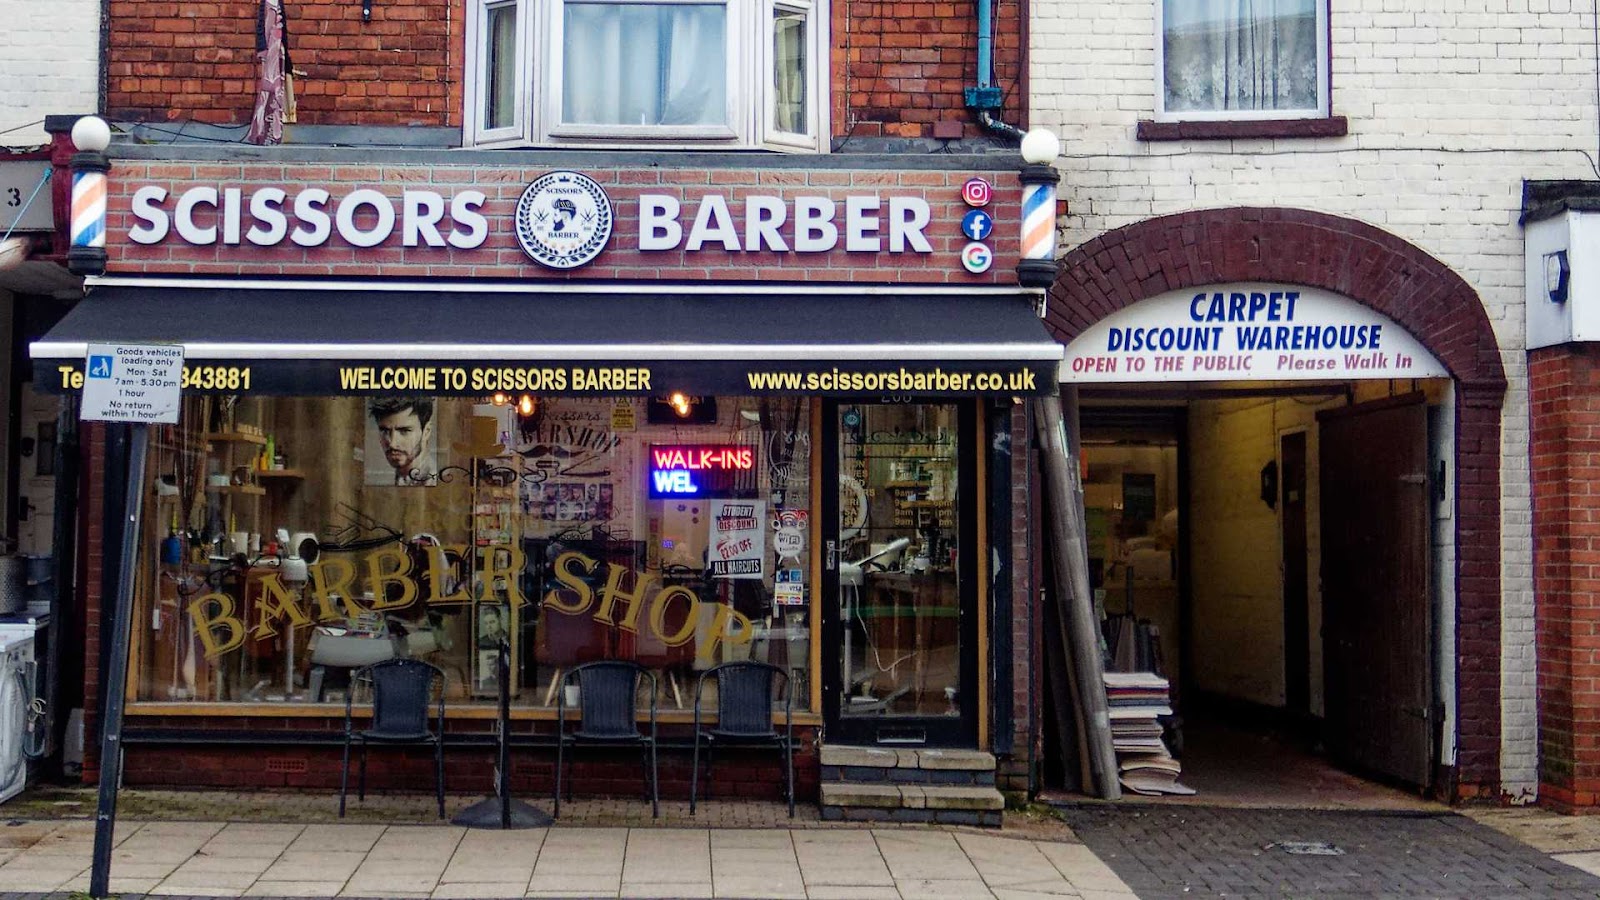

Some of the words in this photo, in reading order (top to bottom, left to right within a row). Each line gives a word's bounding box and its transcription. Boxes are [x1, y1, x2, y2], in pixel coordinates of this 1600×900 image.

[545, 187, 583, 195] SCISSORS
[127, 185, 490, 251] SCISSORS
[638, 194, 934, 254] BARBER
[1189, 291, 1301, 322] CARPET
[1107, 327, 1223, 352] DISCOUNT
[1236, 324, 1382, 351] WAREHOUSE
[116, 347, 144, 356] Goods
[146, 348, 181, 357] vehicles
[121, 357, 153, 366] loading
[155, 358, 174, 367] only
[1071, 356, 1117, 373] OPEN
[1125, 356, 1146, 373] TO
[1153, 355, 1184, 372] THE
[1192, 354, 1253, 372] PUBLIC
[1276, 354, 1337, 371] Please
[1344, 353, 1388, 370] Walk
[1395, 353, 1413, 369] In
[59, 366, 85, 389] Te
[339, 368, 436, 390] WELCOME
[440, 368, 467, 390] TO
[471, 368, 567, 390] SCISSORS
[571, 368, 651, 390] BARBER
[747, 367, 1036, 391] www.scissorsbarber.co.uk
[126, 368, 145, 376] Mon
[152, 368, 167, 377] Sat
[125, 389, 145, 397] hour
[109, 400, 122, 408] No
[124, 401, 152, 409] return
[101, 409, 128, 417] within
[137, 410, 157, 418] hour
[654, 450, 752, 469] WALK-INS
[722, 505, 754, 517] STUDENT
[718, 518, 757, 531] DISCOUNT
[740, 538, 752, 552] OFF
[714, 561, 726, 574] ALL
[728, 560, 760, 573] HAIRCUTS
[186, 544, 531, 662] BARBER
[543, 551, 753, 661] SHOP
